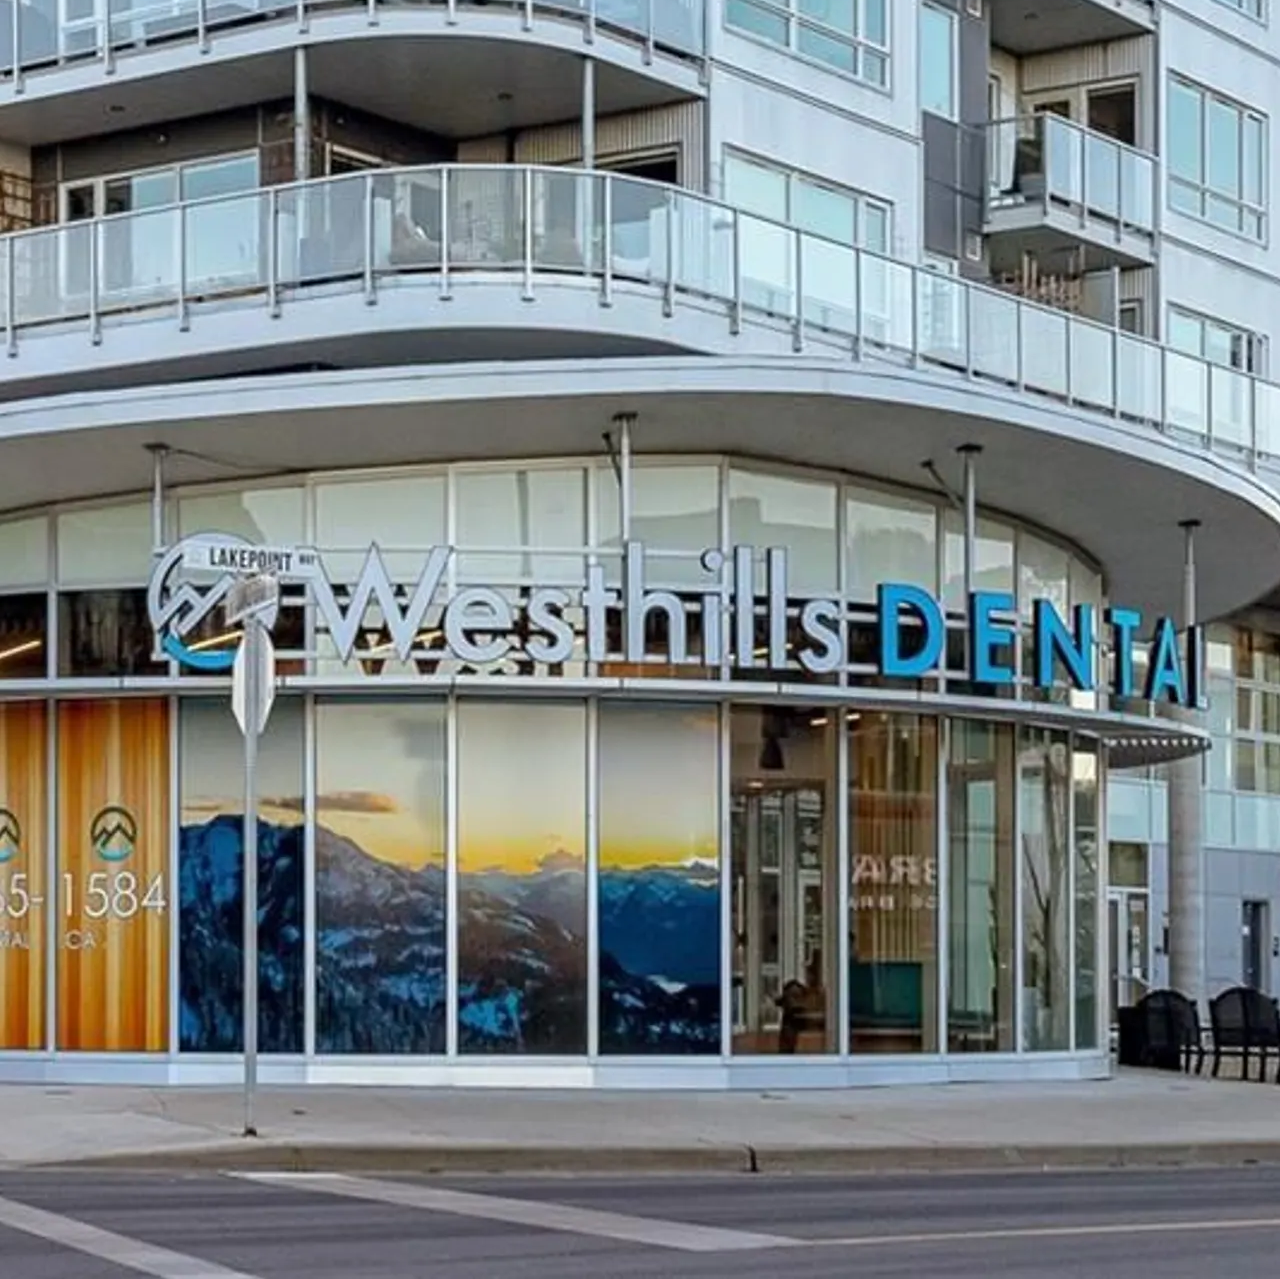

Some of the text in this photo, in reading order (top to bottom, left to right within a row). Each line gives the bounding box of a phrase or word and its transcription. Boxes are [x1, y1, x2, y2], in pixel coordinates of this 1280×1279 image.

[209, 546, 292, 572] LAKEPOINT
[297, 540, 1209, 709] Westhills DENTAL
[62, 873, 166, 919] 1584
